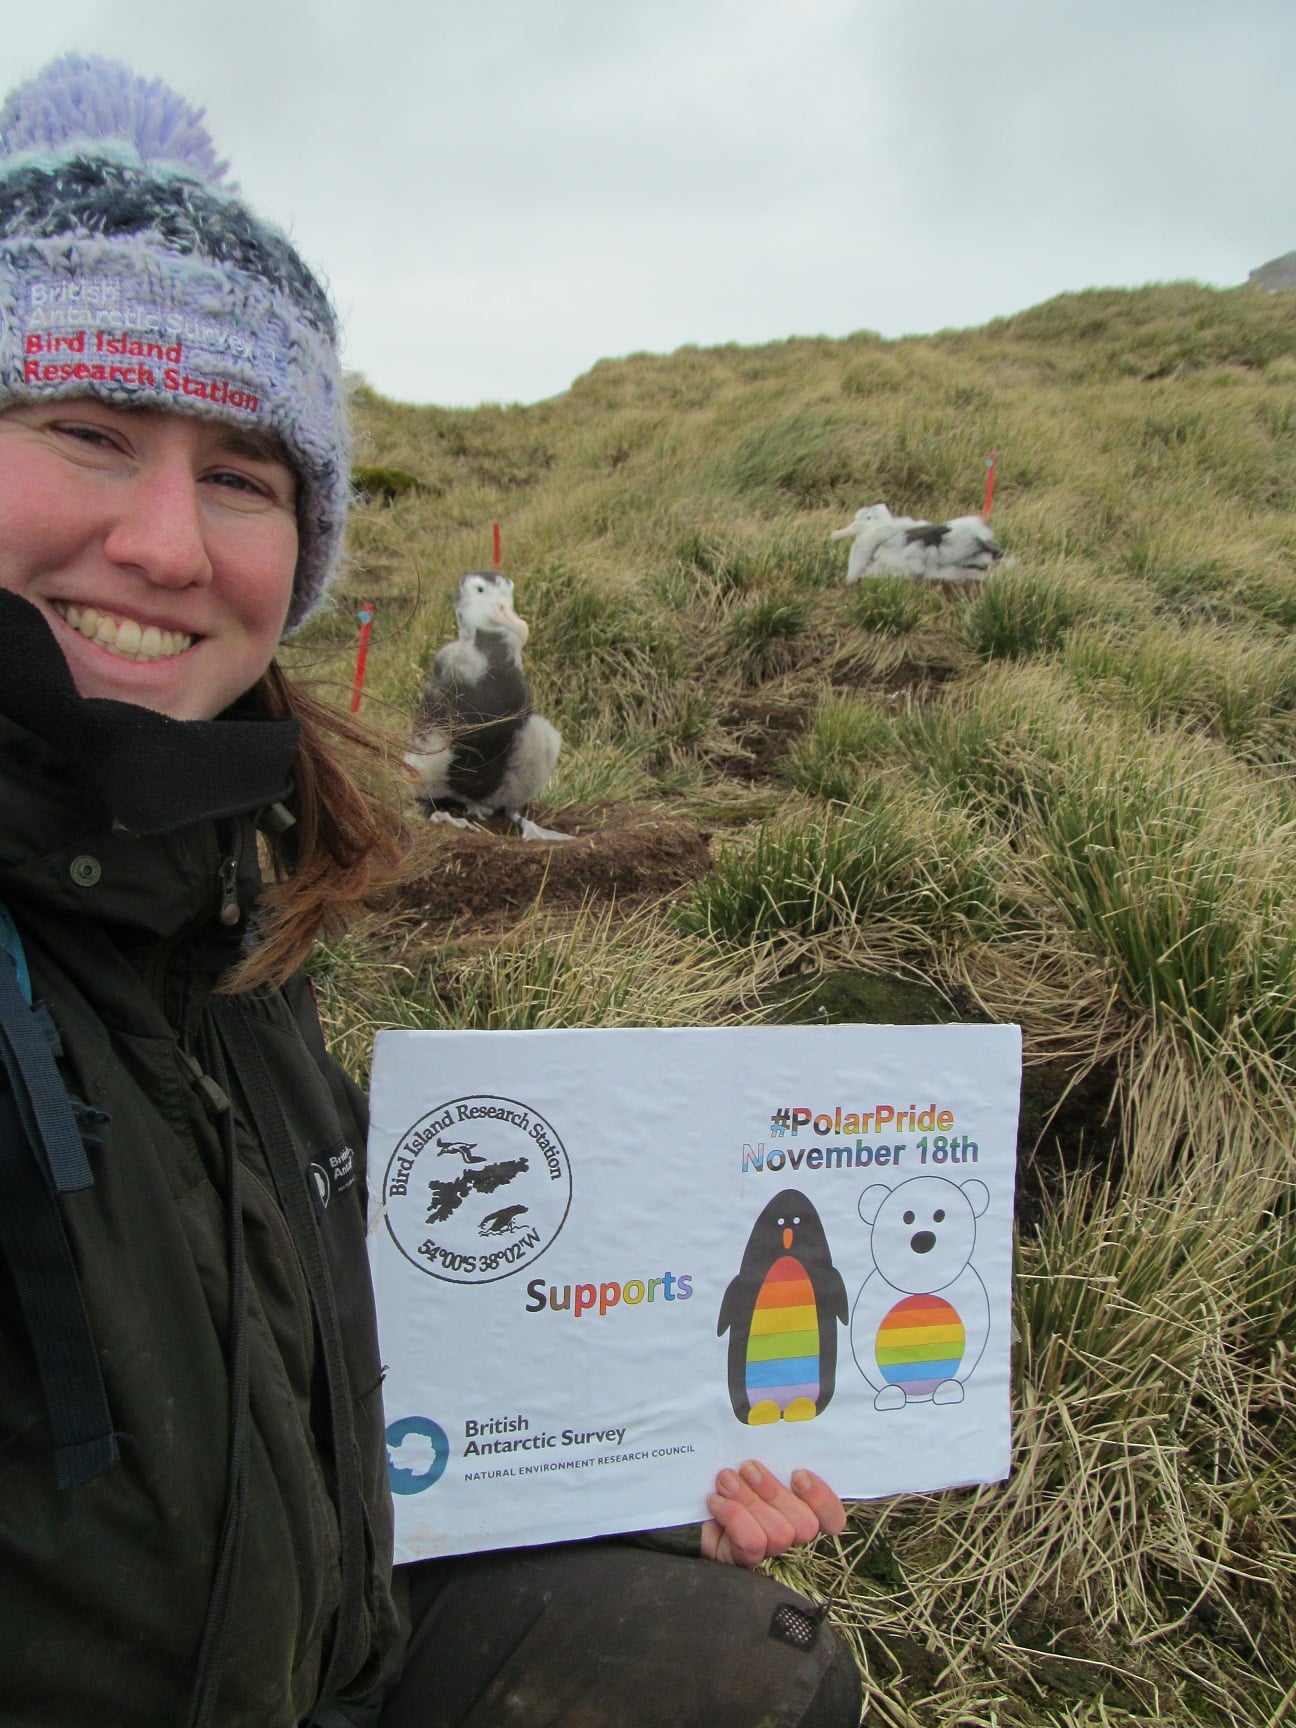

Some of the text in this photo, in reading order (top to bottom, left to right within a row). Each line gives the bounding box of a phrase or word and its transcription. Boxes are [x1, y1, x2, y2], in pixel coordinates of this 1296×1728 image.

[29, 281, 120, 305] British
[28, 305, 162, 330] Antarctic
[25, 331, 183, 364] Bird Island
[24, 360, 259, 412] Research Station
[770, 1104, 955, 1138] #PolarPride
[390, 1157, 415, 1197] Bird
[404, 1111, 454, 1157] Island
[456, 1104, 529, 1131] Research
[529, 1123, 562, 1180] Station
[742, 1135, 980, 1173] November 18th
[525, 1271, 694, 1318] Supports
[463, 1427, 626, 1457] Antarctic Survey
[465, 1415, 529, 1437] British
[464, 1444, 696, 1481] NATURAL ENVIRONMENT RESEARCH COUNCIL
